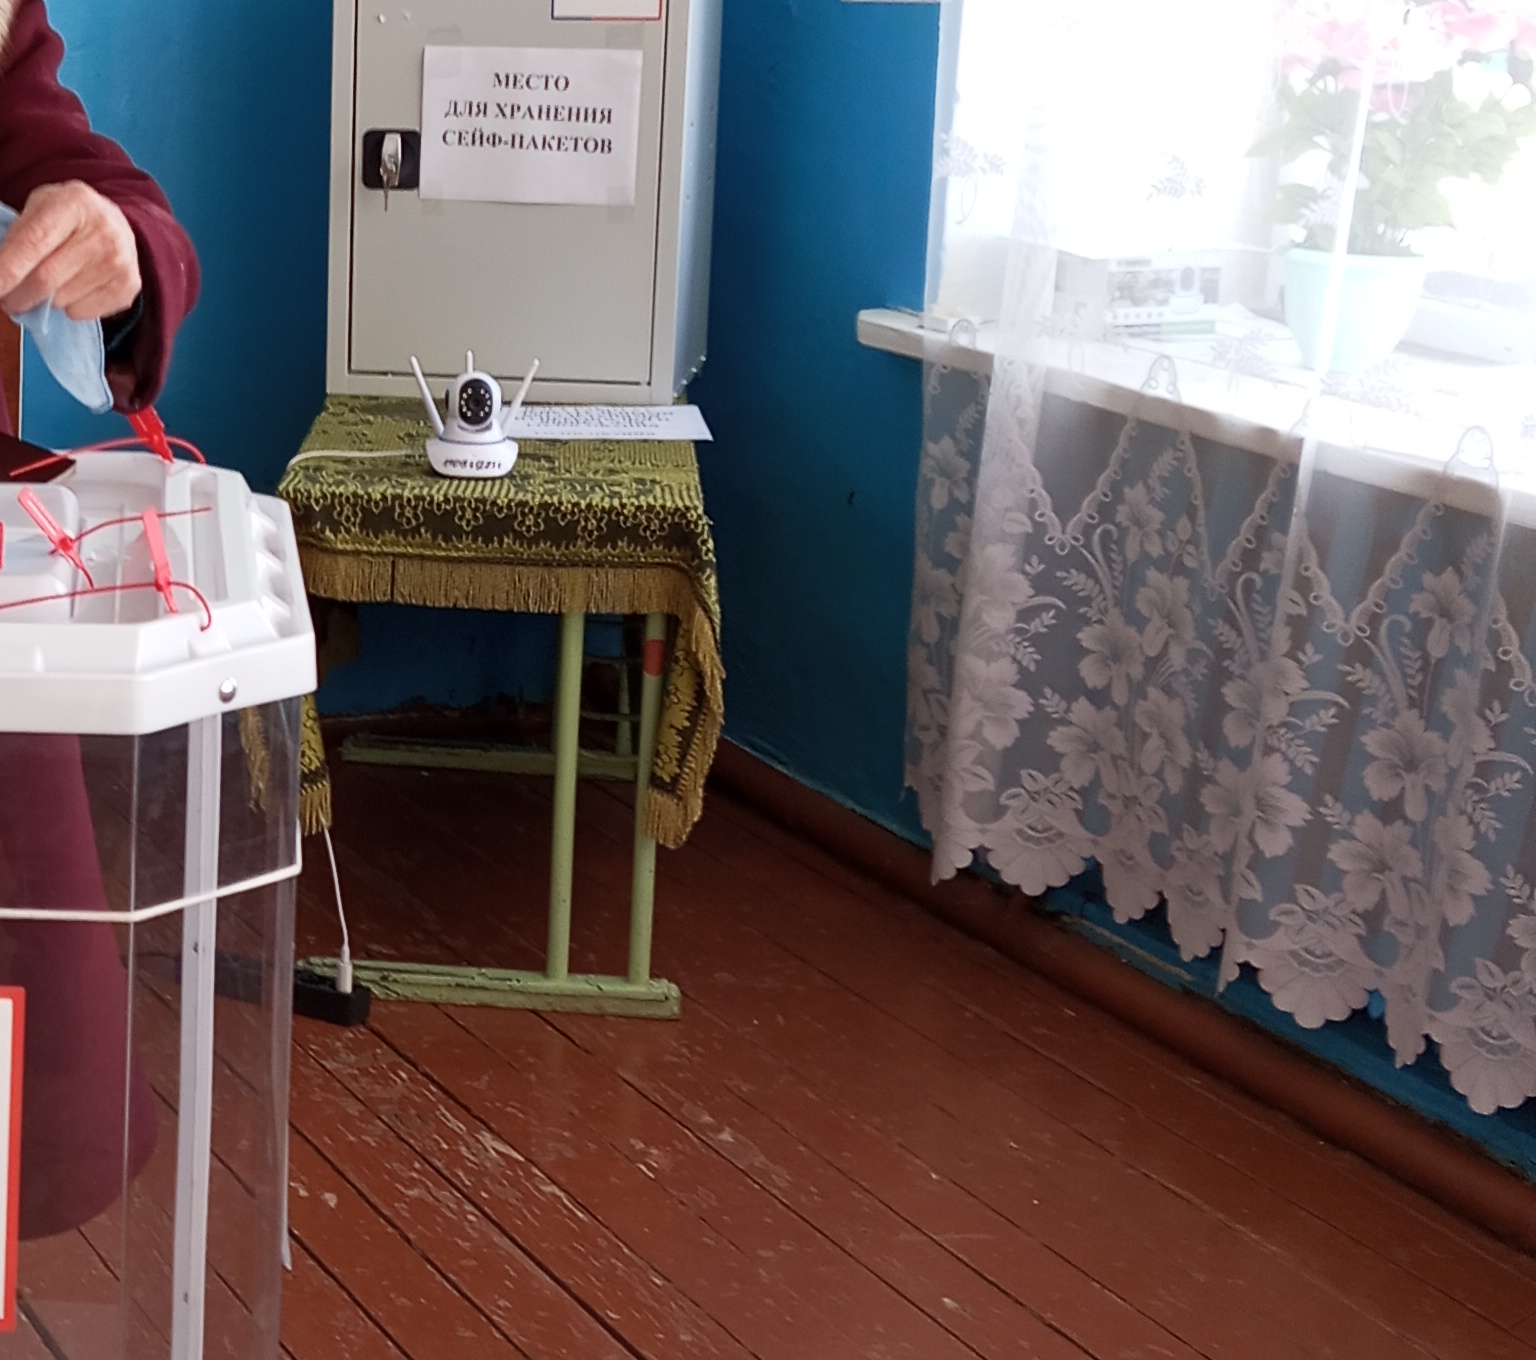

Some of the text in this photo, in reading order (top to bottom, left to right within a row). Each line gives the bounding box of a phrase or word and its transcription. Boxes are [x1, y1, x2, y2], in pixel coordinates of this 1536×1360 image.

[492, 72, 570, 92] МЕСТО
[443, 99, 613, 124] ДЛЯ ХРАНЕНИЯ
[441, 127, 613, 155] СЕЙФ-ПАКЕТОВ
